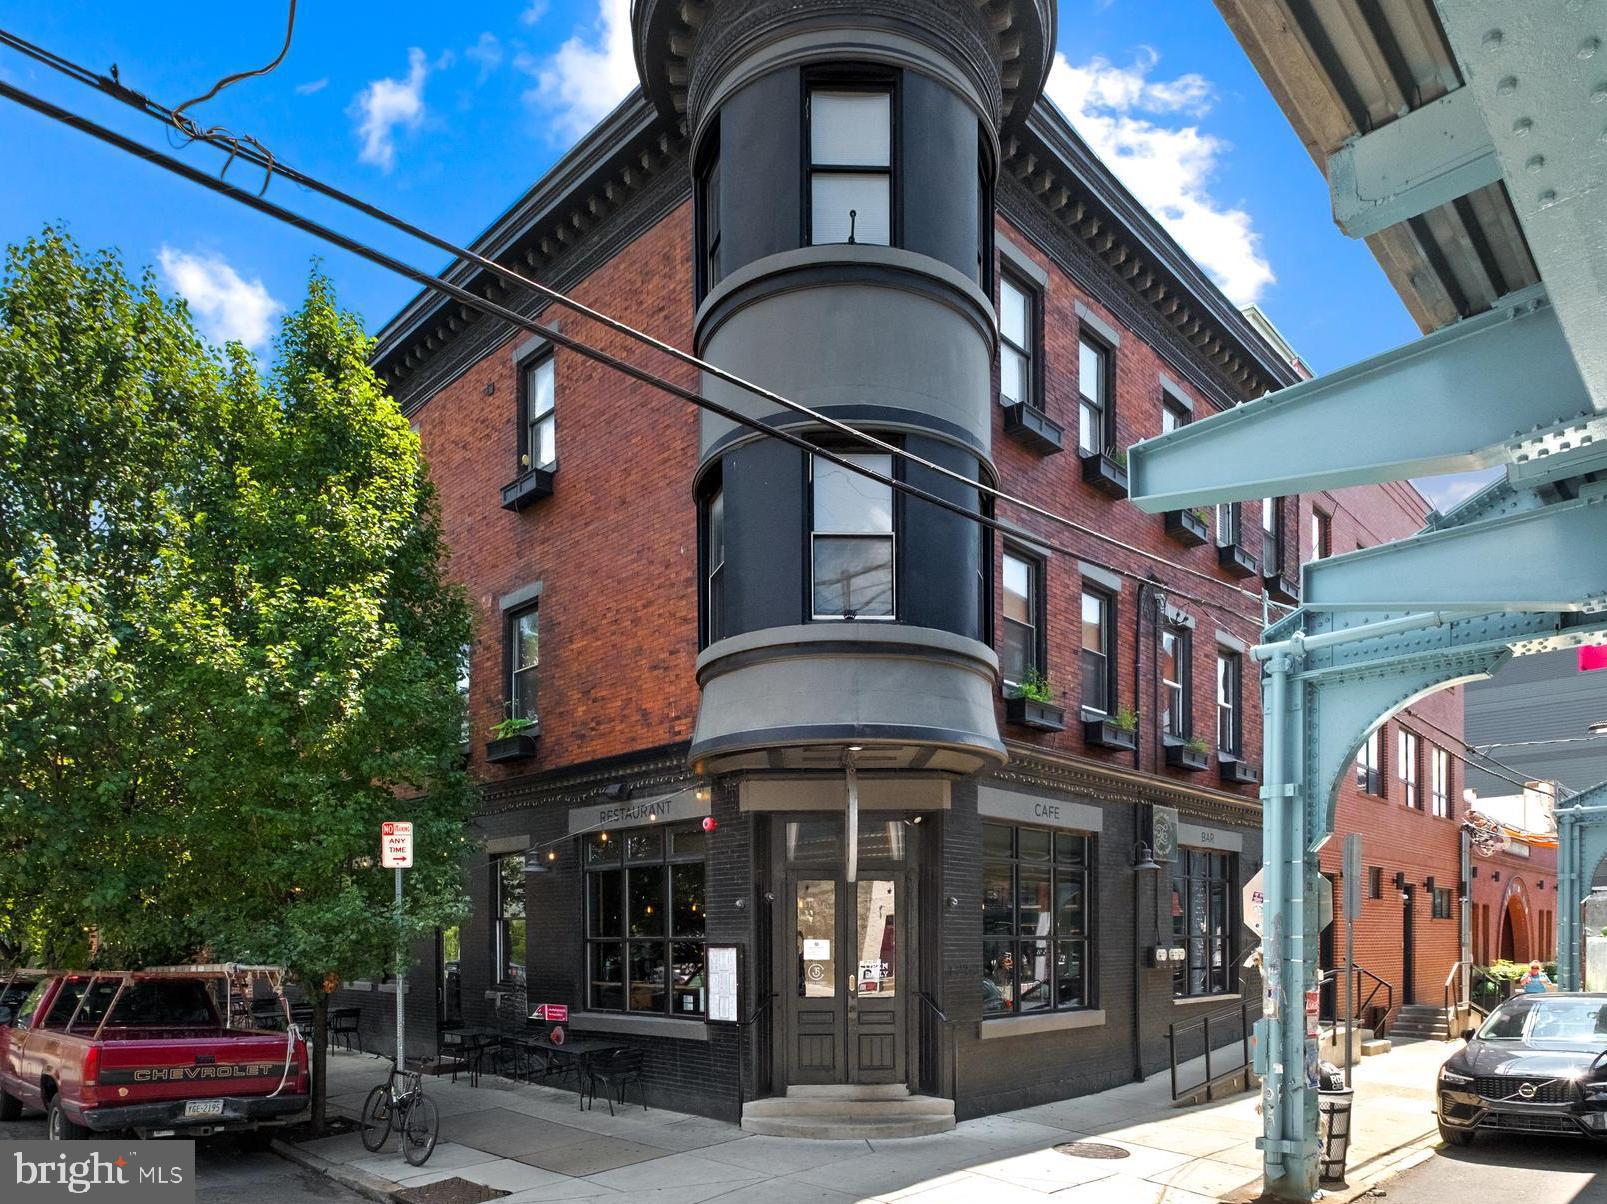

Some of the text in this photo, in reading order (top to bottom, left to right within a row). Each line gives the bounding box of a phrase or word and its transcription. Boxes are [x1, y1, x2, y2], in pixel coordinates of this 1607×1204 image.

[600, 800, 672, 823] RESTAURANT
[1034, 803, 1061, 819] CAFE
[383, 824, 394, 835] NO
[1201, 831, 1215, 843] BAR
[134, 1064, 273, 1081] CHEVROLET
